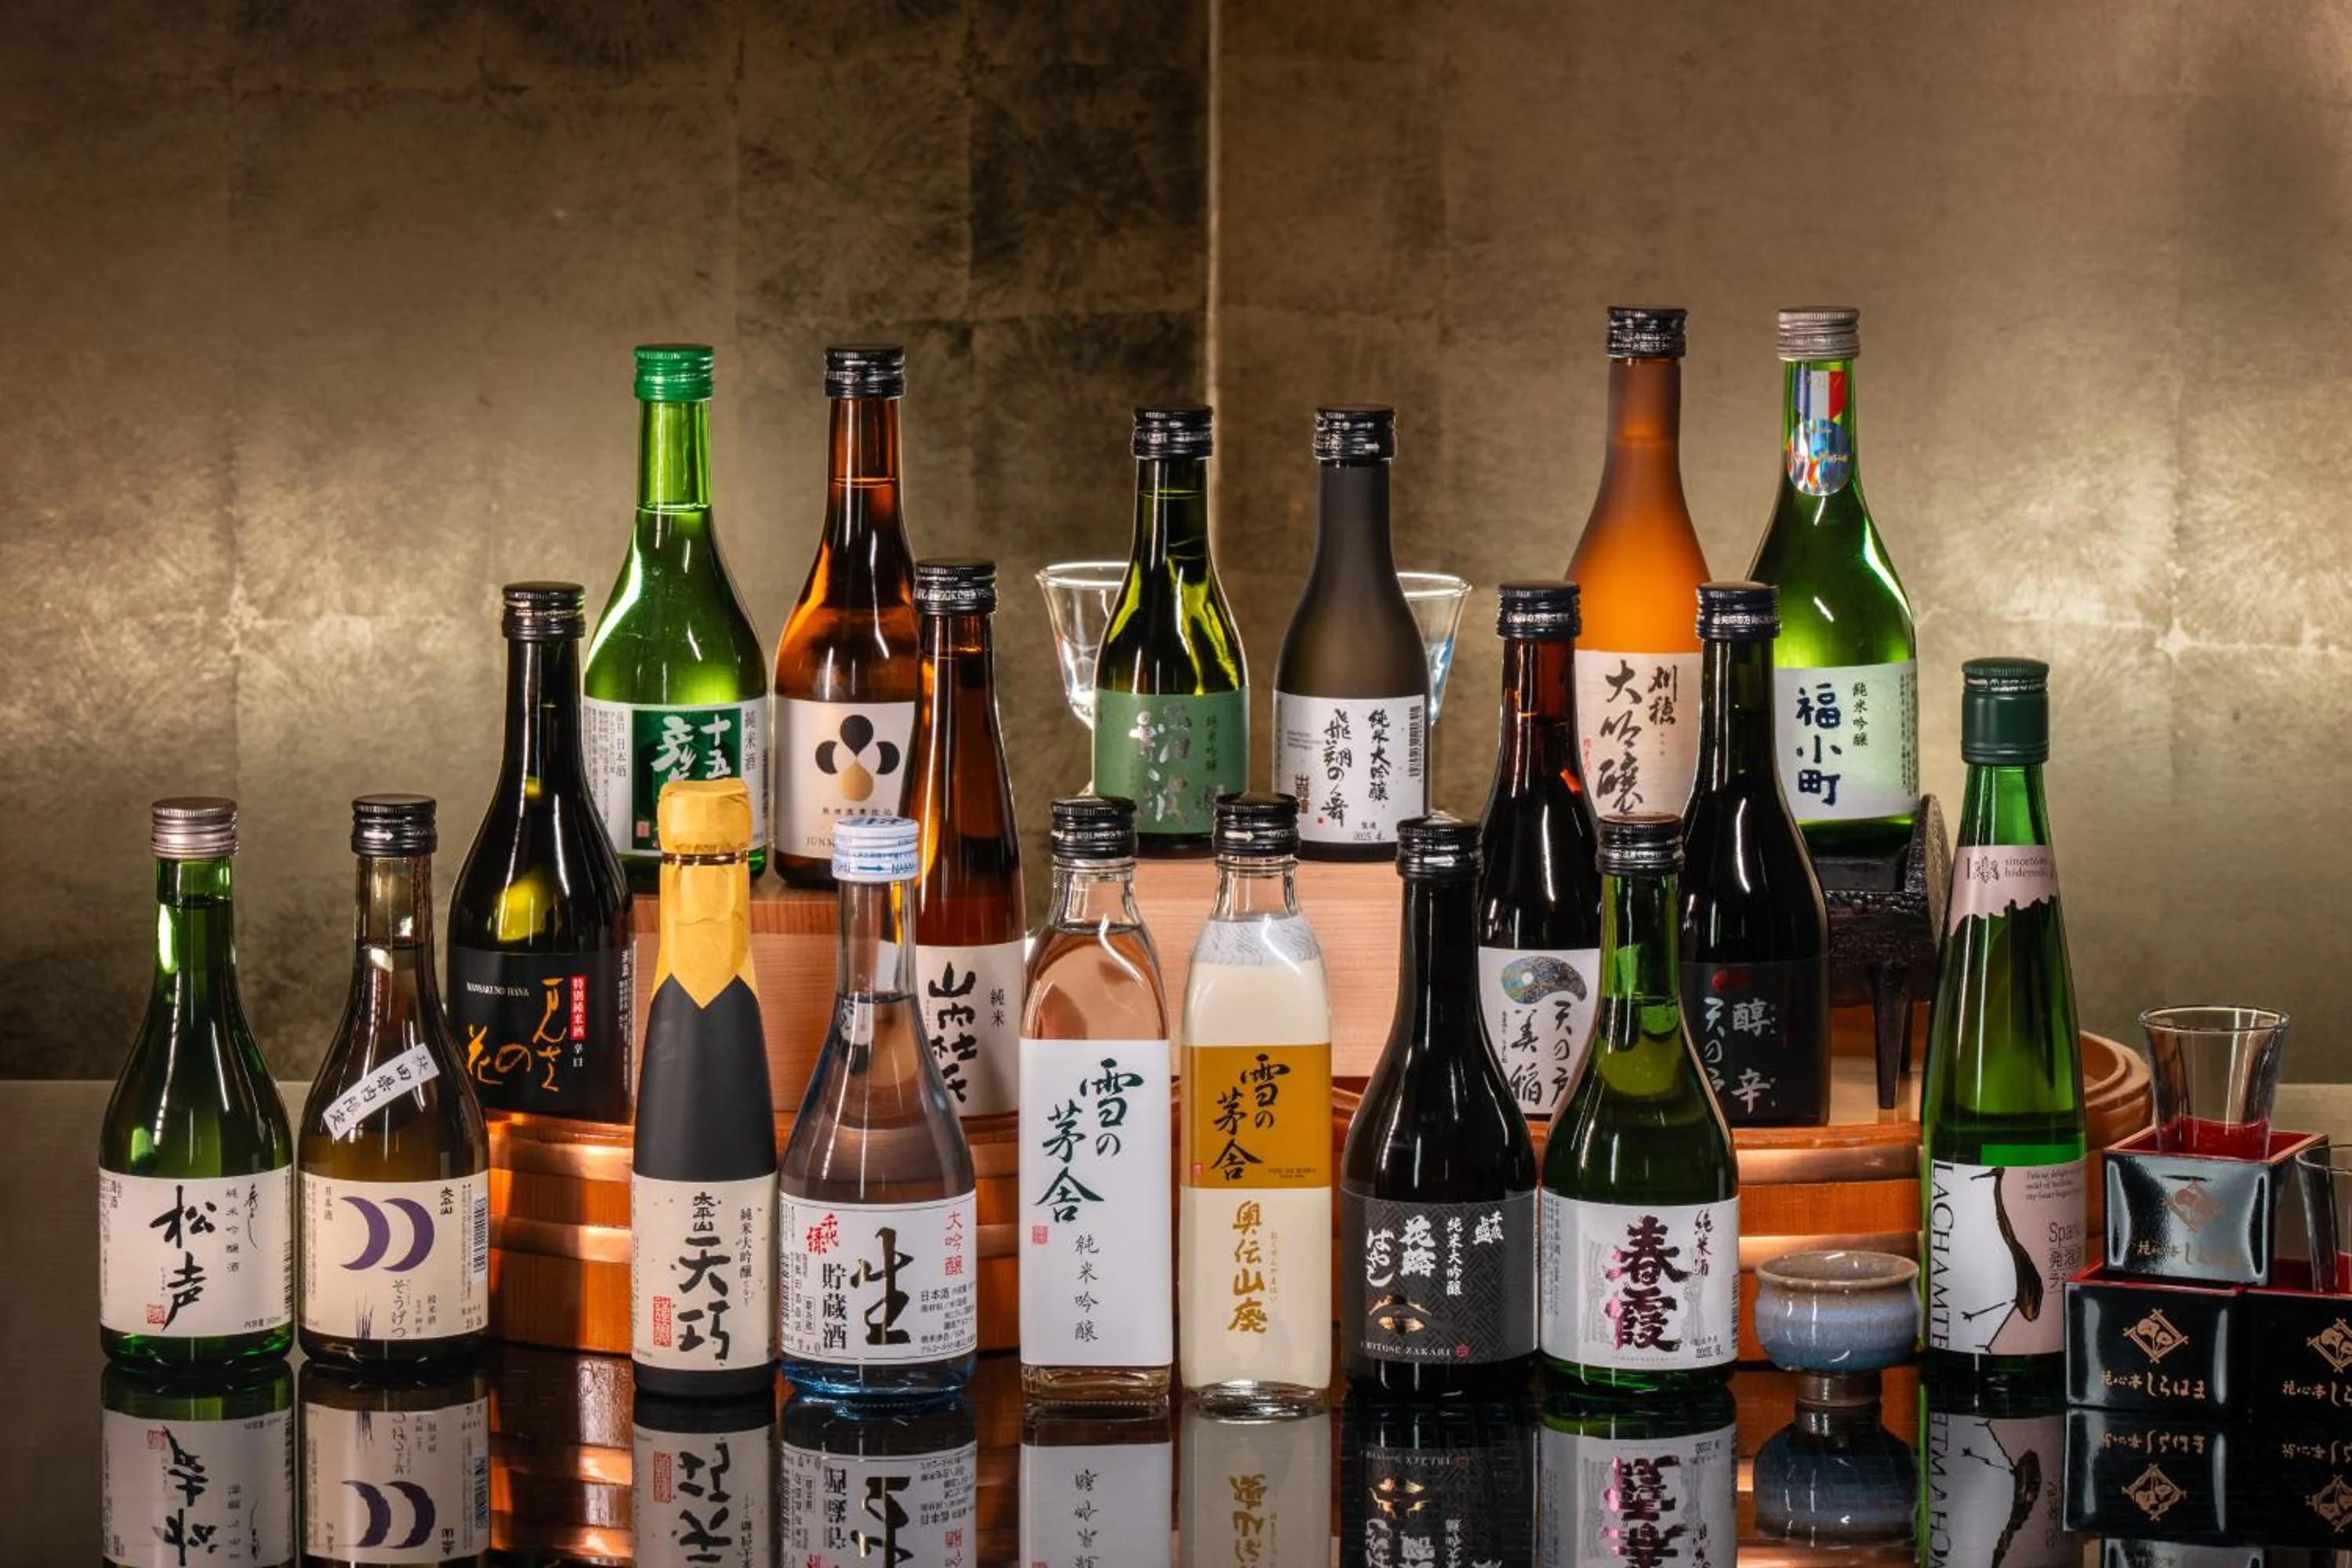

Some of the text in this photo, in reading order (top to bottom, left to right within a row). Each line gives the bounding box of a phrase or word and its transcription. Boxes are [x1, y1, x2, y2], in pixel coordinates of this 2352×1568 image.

[1648, 665, 1678, 725] 刈穂
[1853, 682, 1868, 747] 純米吟醸
[700, 713, 731, 779] 十五
[1321, 709, 1352, 826] 飛翔の舞
[1368, 709, 1391, 801] 純米大吟醸
[1596, 659, 1643, 815] 大吟醸
[1796, 683, 1842, 806] 福小町
[990, 988, 1004, 1028] 純米
[226, 1188, 239, 1272] 純米吟醸酒
[692, 1192, 715, 1232] 太平山
[740, 1208, 753, 1279] 純米大吟醸
[945, 1210, 964, 1276] 大吟醸
[1694, 1209, 1713, 1276] 純米酒
[150, 1185, 216, 1331] 松声
[851, 1226, 914, 1345] 生
[920, 1288, 949, 1301] 日本酒
[1075, 1235, 1099, 1342] 純米吟醸
[1228, 1200, 1268, 1334] 奥伝山廃
[1446, 1218, 1463, 1296] 純米大吟醸
[1604, 1215, 1692, 1352] 春霞
[1932, 1163, 1955, 1348] LACHAMTE
[392, 1279, 406, 1338] そうげつ
[677, 1236, 731, 1361] 天巧
[823, 1263, 847, 1349] 貯蔵酒
[1406, 1345, 1450, 1356] ZAKARI
[2100, 1370, 2206, 1400] 花心亭しらはま
